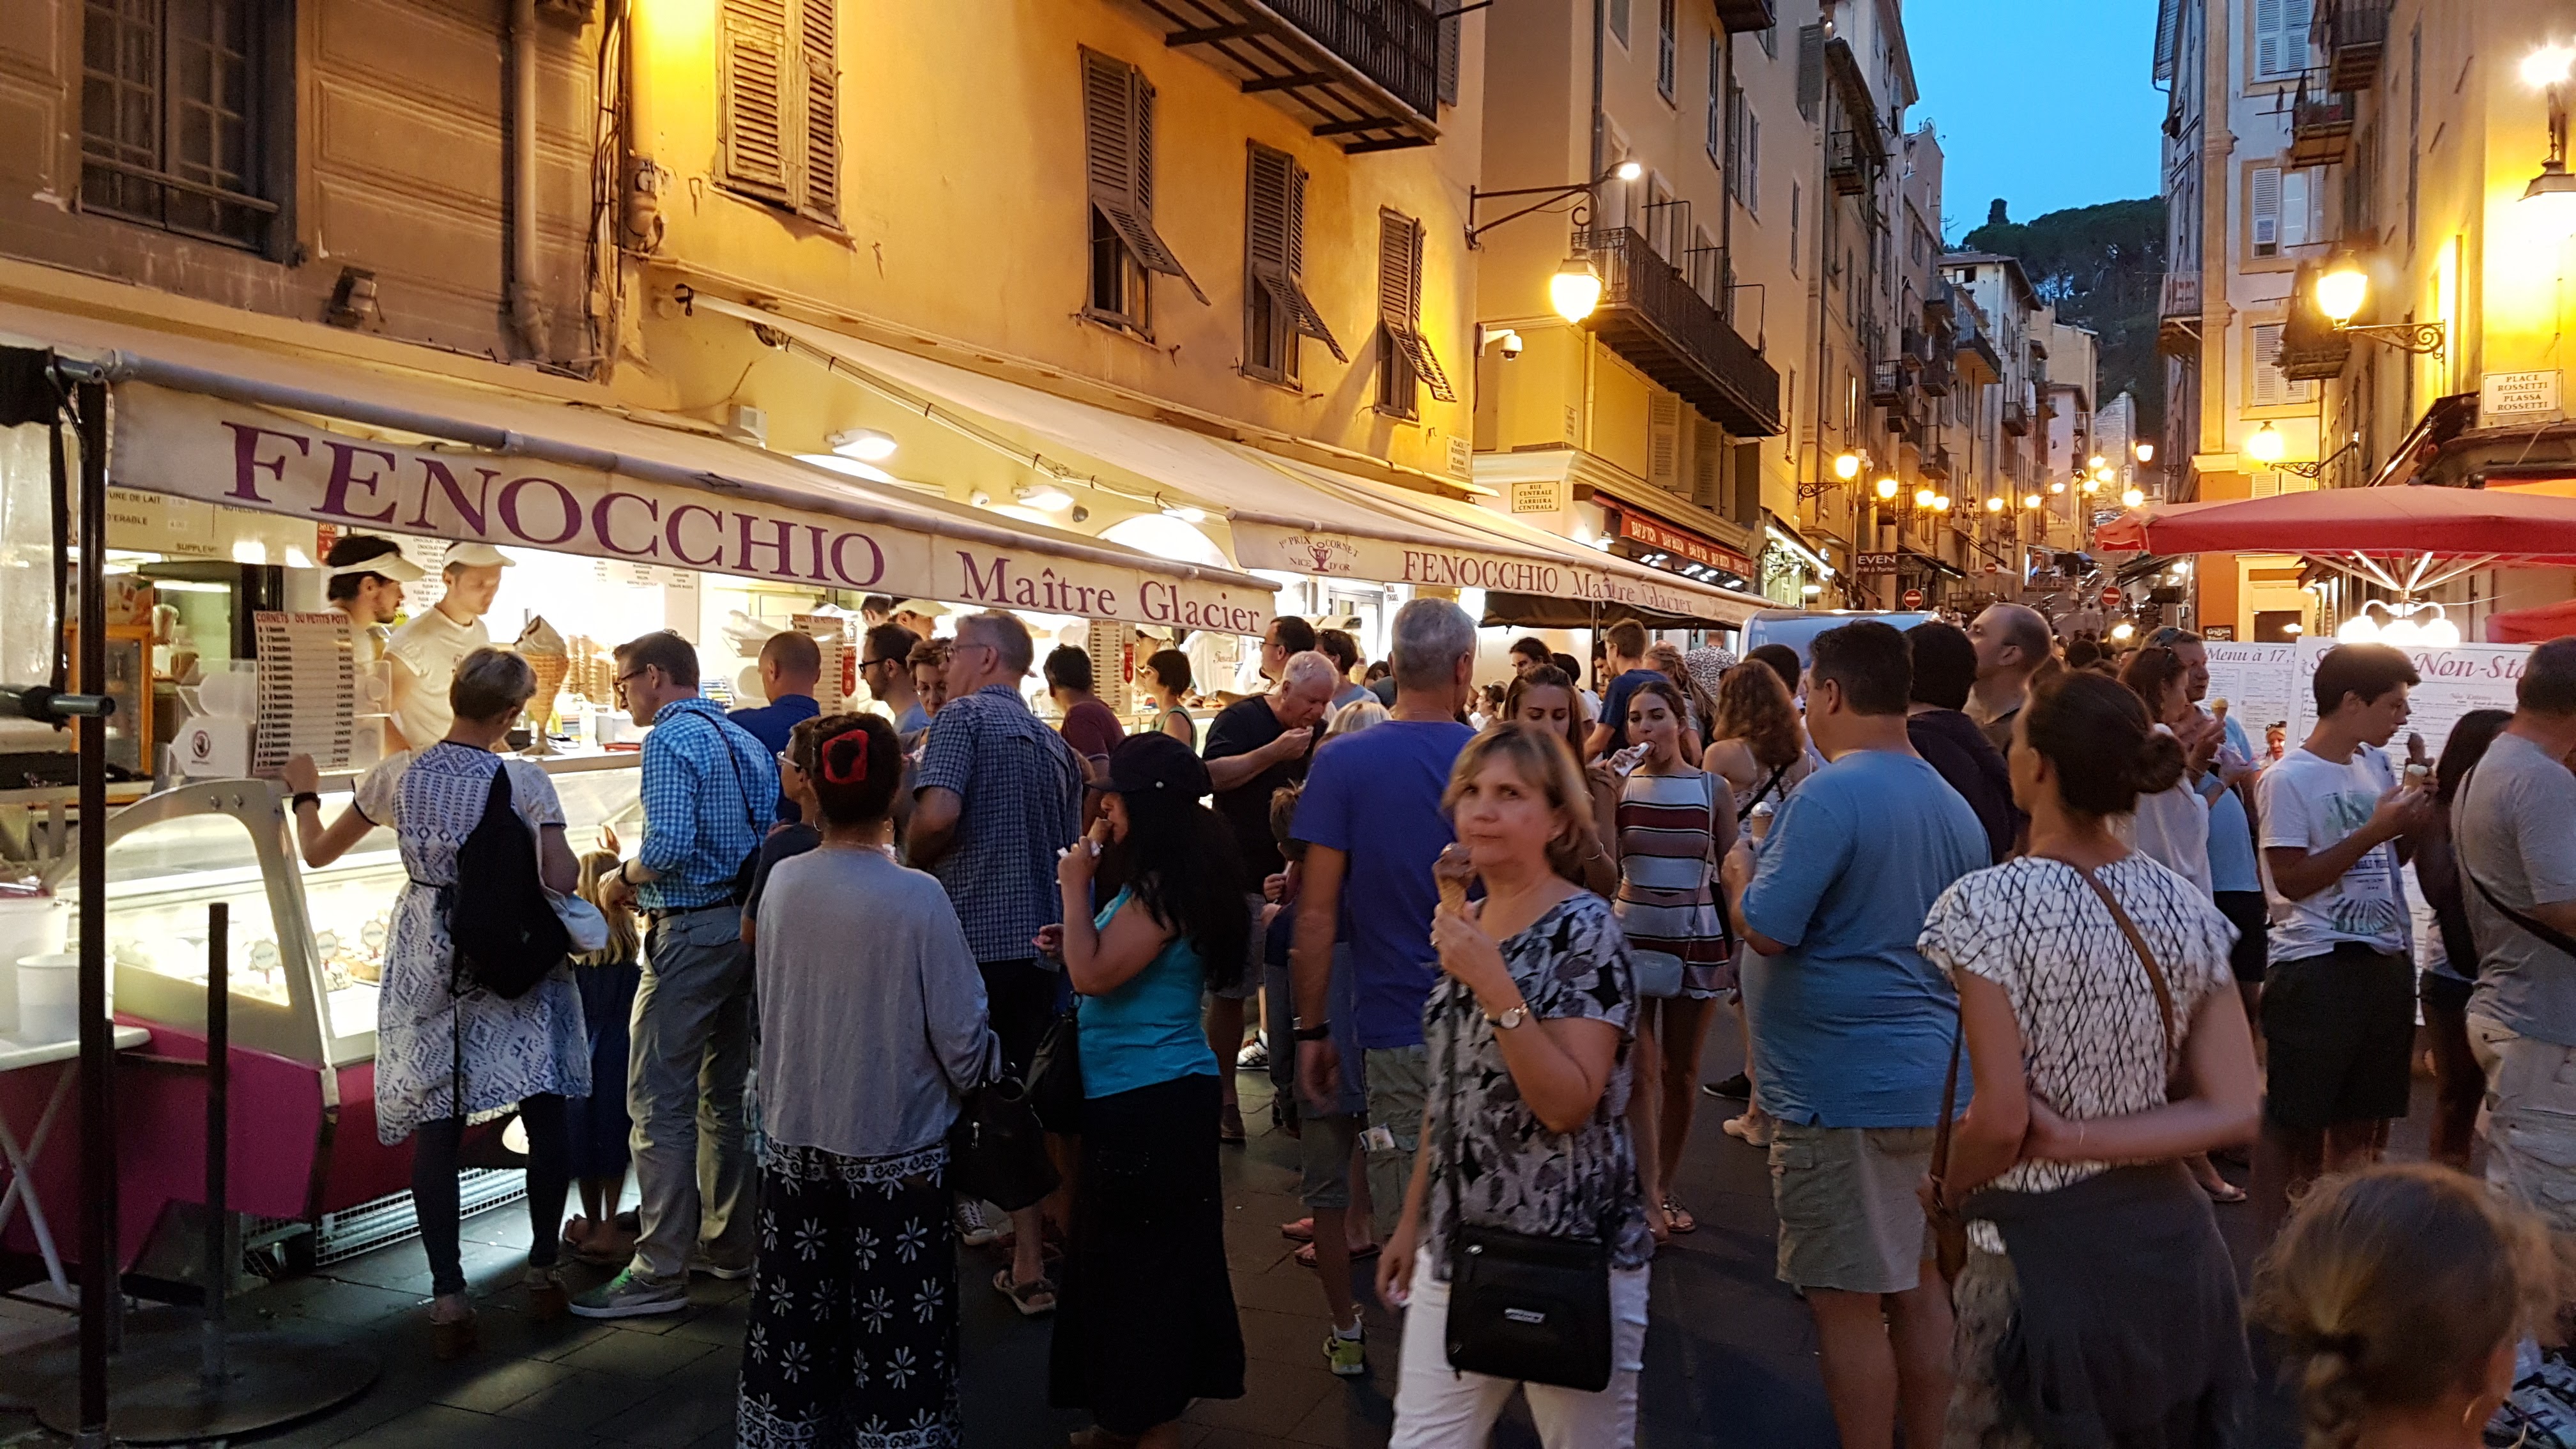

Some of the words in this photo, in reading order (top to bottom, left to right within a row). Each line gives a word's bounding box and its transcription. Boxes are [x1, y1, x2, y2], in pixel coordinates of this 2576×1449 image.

[2506, 374, 2540, 383] PLACE
[2497, 382, 2548, 392] ROSSETTI
[2504, 394, 2542, 402] PLASSA
[2497, 401, 2548, 411] ROSSETTI
[221, 420, 885, 586] FENOCCHIO
[956, 550, 1117, 616] Maître
[1140, 580, 1260, 632] Glacier
[1288, 536, 1311, 545] PRIX
[1325, 539, 1360, 558] CORNET
[1289, 556, 1312, 567] NICE
[1857, 555, 1896, 565] EVEN
[1402, 551, 1558, 594] FENOCCHIO
[1641, 583, 1692, 613] Glacier
[256, 612, 289, 624] CORNETS
[331, 614, 349, 625] POTS
[2205, 647, 2248, 662] Menu
[2252, 648, 2263, 662] à
[2269, 649, 2295, 664] 17,
[2413, 650, 2525, 680] Non-Sto
